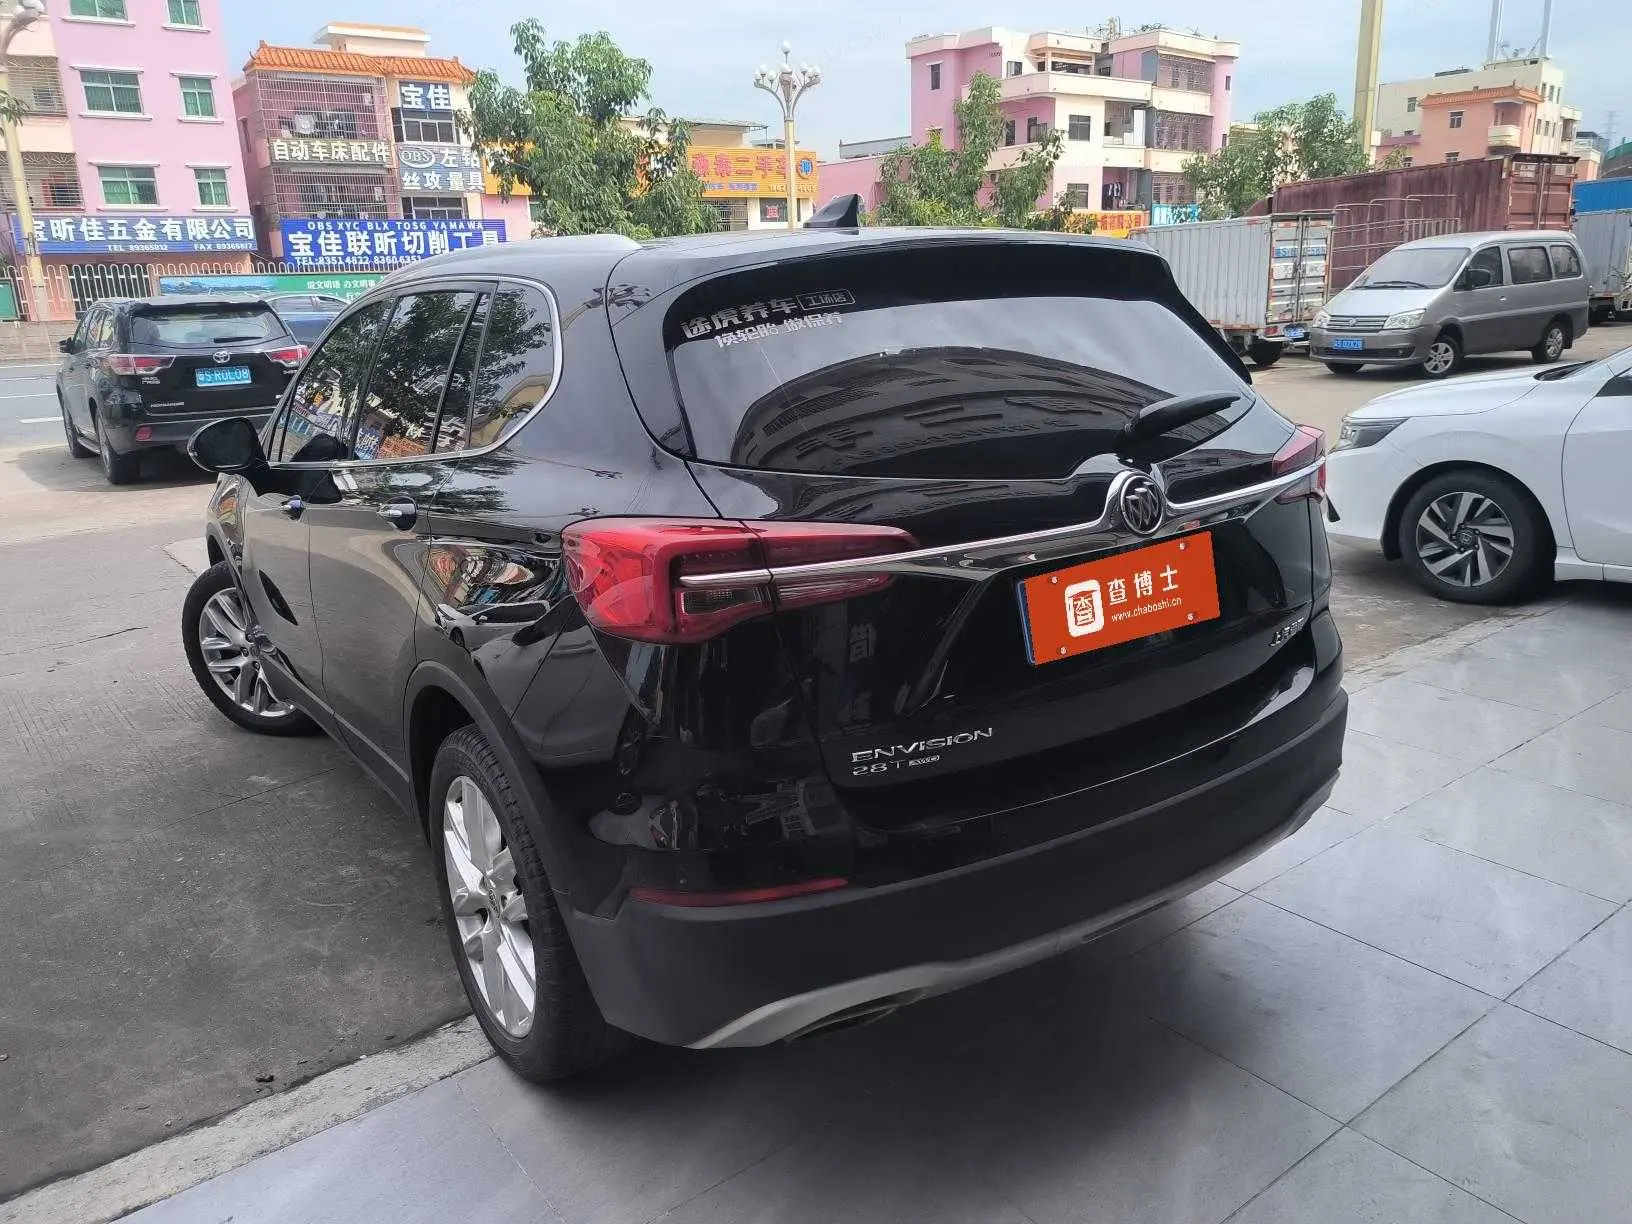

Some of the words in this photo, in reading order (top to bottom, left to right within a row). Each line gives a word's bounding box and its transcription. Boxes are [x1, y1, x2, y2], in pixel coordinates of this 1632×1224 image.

[401, 84, 451, 110] 宝佳
[273, 140, 390, 162] 自动车床配件
[402, 150, 430, 162] OBS
[403, 172, 484, 191] 丝攻量具
[307, 221, 333, 231] OBS
[337, 221, 360, 231] XYC
[367, 221, 389, 231] BLX
[396, 221, 427, 231] TOSG
[433, 221, 484, 231] YAMAWA
[288, 230, 498, 257] 宝佳联昕切削工具
[680, 297, 797, 338] 途虎养车
[714, 322, 779, 347] 换轮胎
[851, 727, 993, 763] ENVISION
